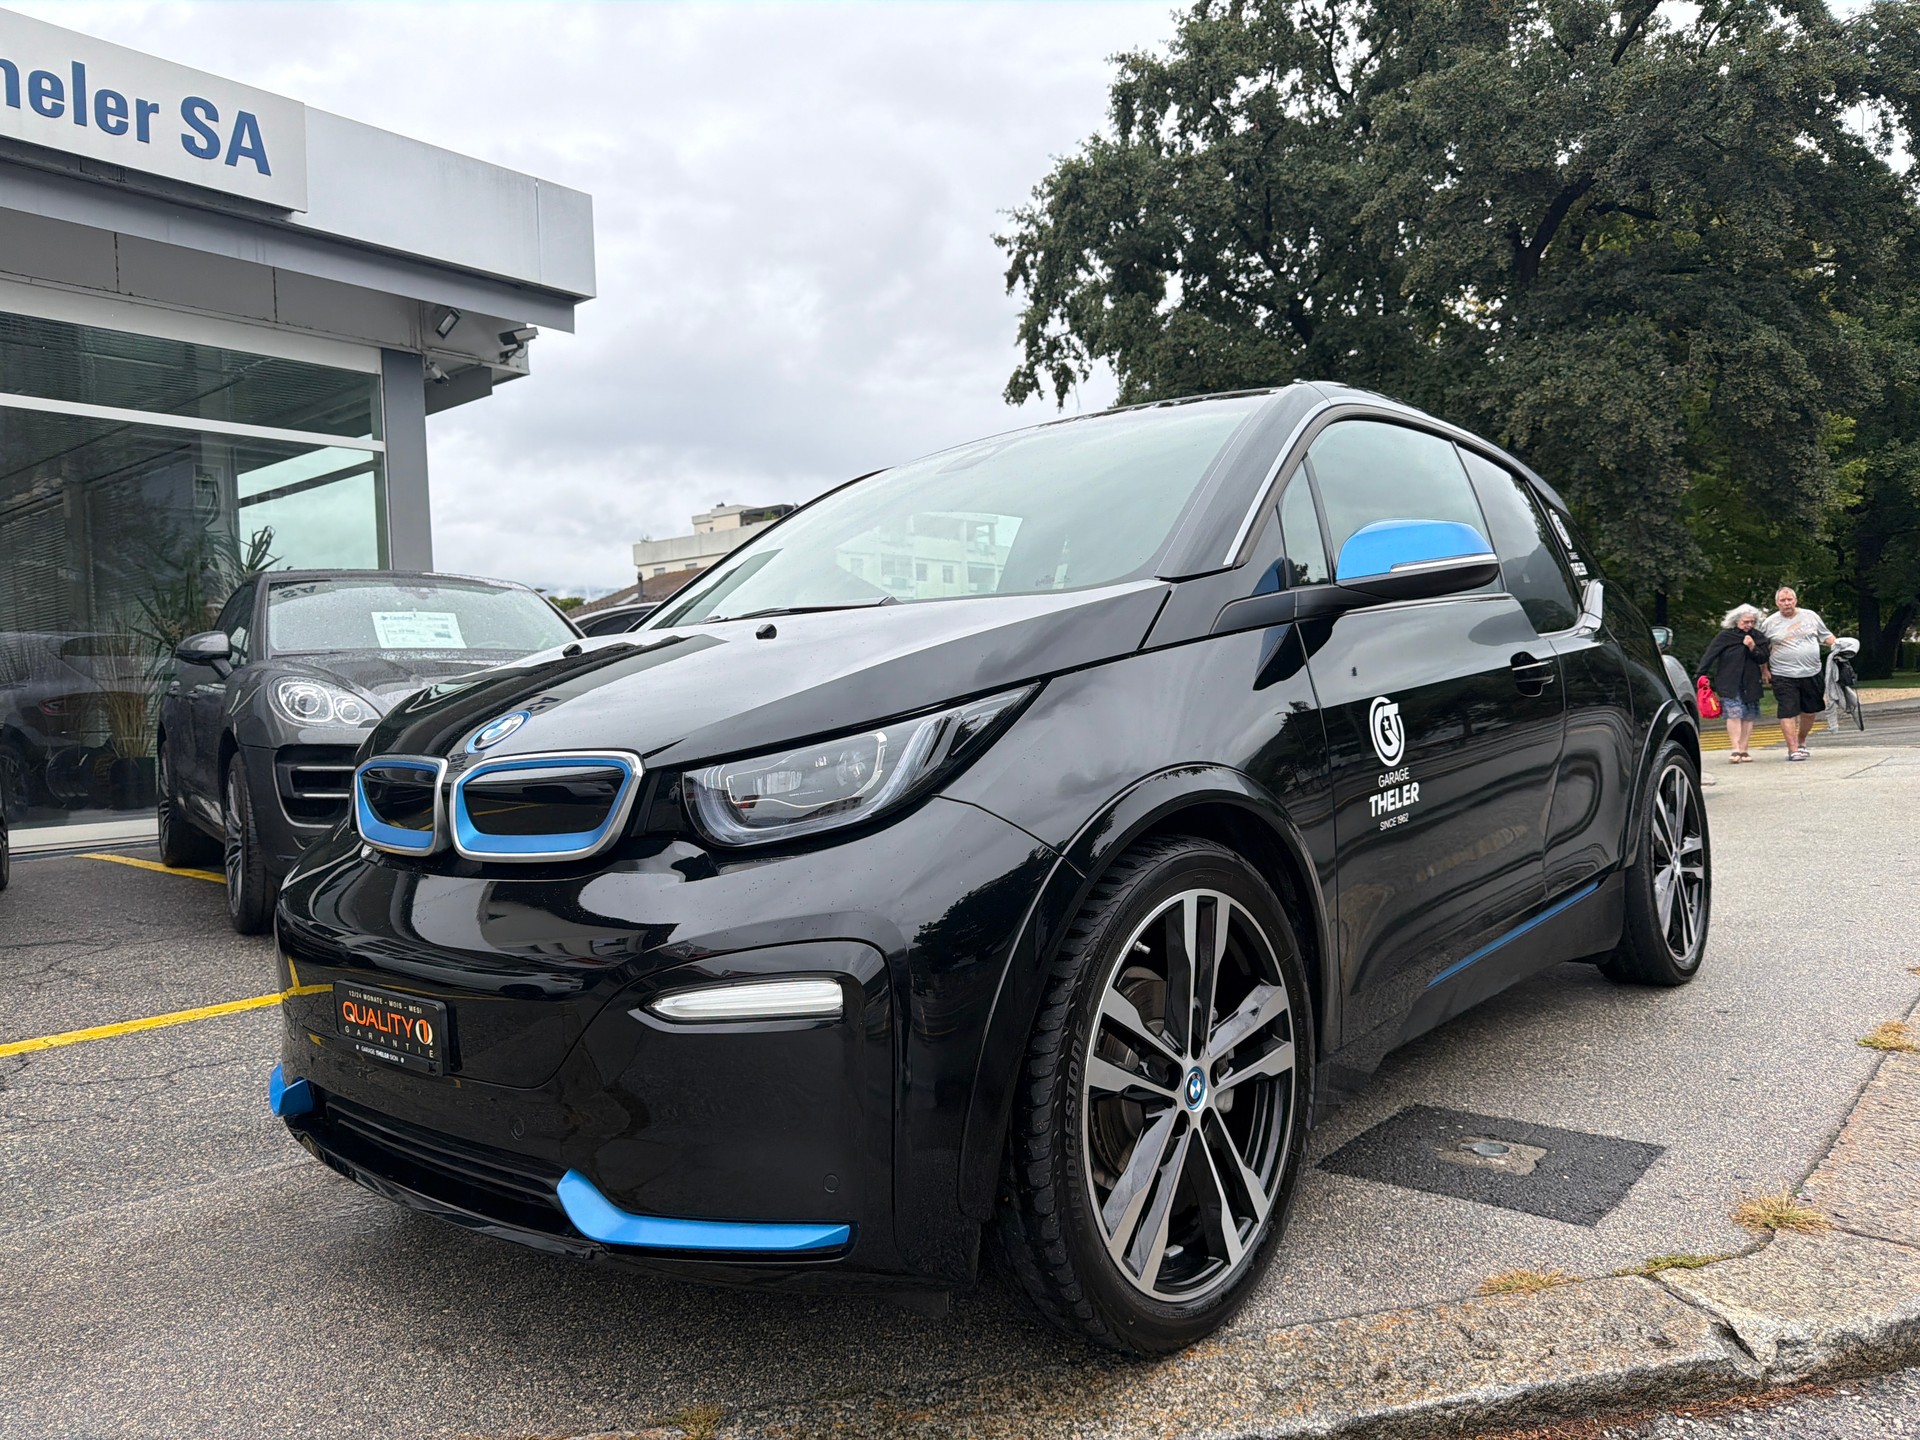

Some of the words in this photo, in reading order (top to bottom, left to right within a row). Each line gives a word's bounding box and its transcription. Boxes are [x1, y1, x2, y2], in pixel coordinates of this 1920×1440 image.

[180, 95, 272, 177] SA
[1378, 767, 1410, 788] GARAGE
[1369, 782, 1420, 818] THELER
[1379, 816, 1397, 831] SINCE
[343, 1001, 414, 1039] QUALITY
[363, 993, 383, 1005] MONATE
[388, 1000, 403, 1010] MOIS
[408, 1004, 423, 1014] MESI
[344, 1025, 434, 1058] GARANTIE
